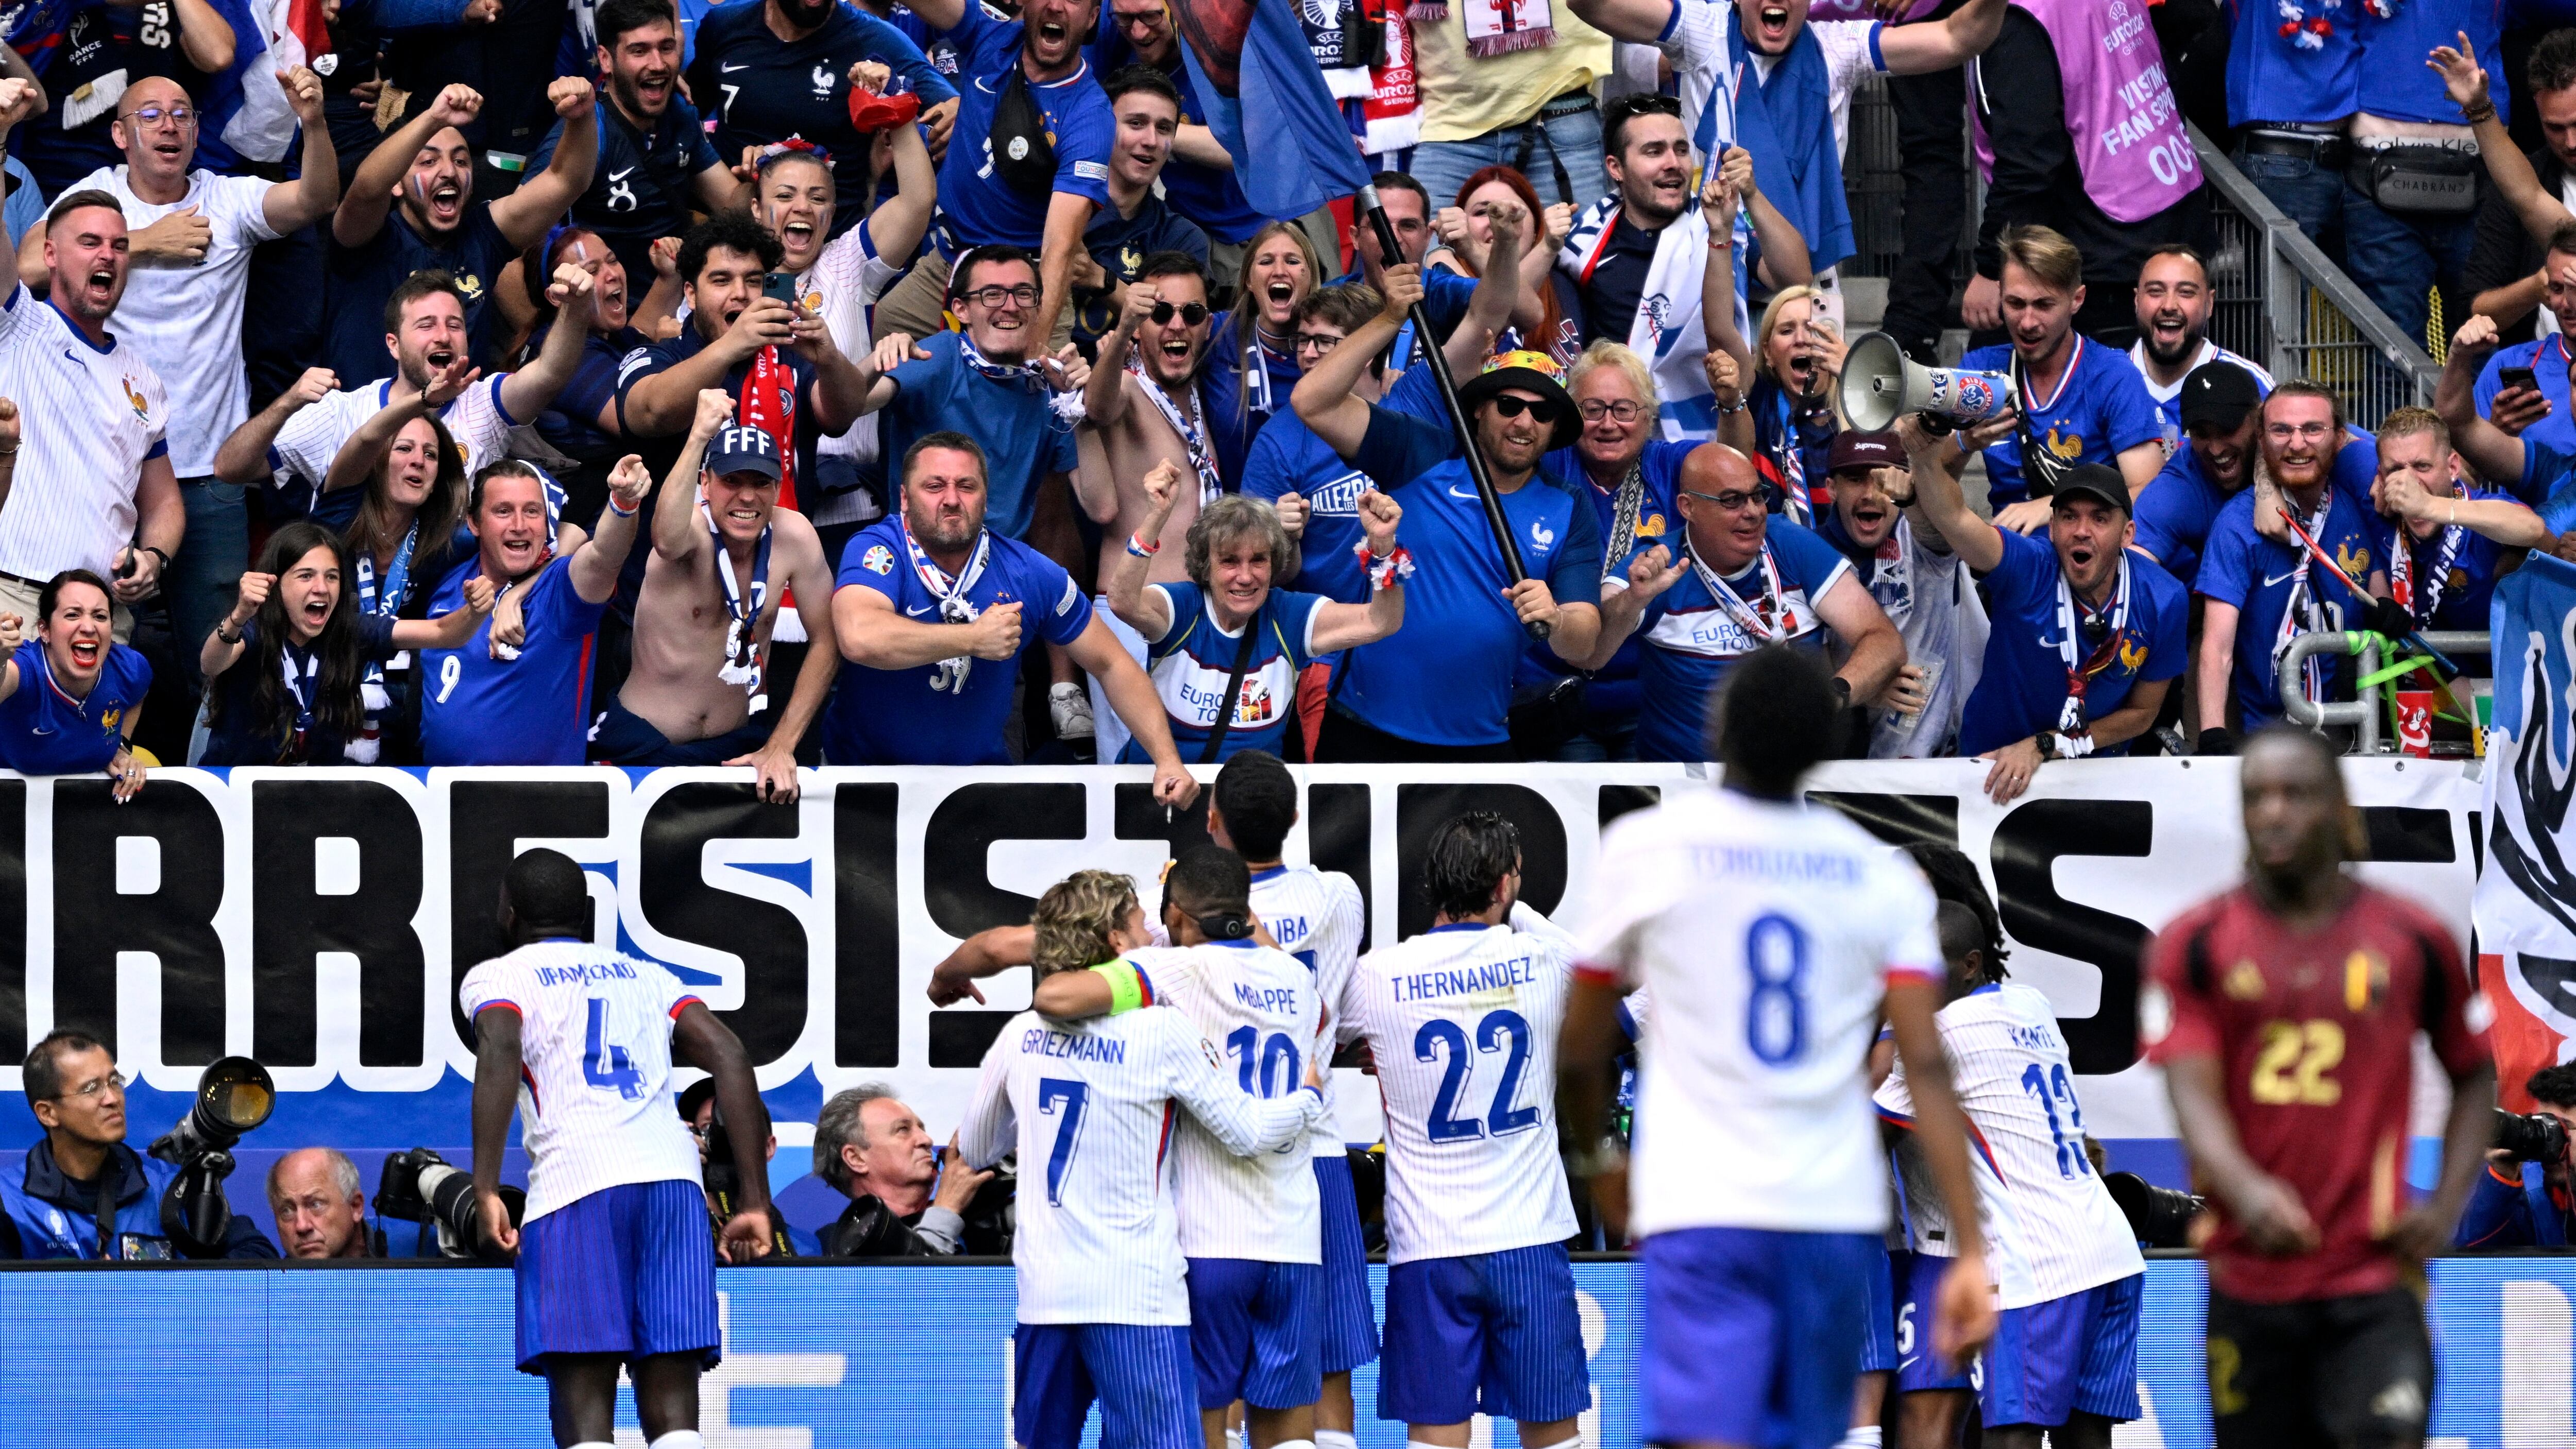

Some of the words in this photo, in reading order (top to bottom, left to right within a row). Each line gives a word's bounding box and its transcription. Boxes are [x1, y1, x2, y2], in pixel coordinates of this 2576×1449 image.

[1386, 72, 1412, 82] UEFA
[721, 83, 740, 124] 7
[2102, 109, 2155, 156] FAN
[724, 427, 770, 454] FFF
[1854, 442, 1887, 452] Supreme
[1312, 481, 1353, 513] ALLEZ
[1344, 501, 1355, 512] LES
[1692, 623, 1749, 644] EURO
[436, 655, 461, 704] 9
[1180, 683, 1240, 708] EURO
[1197, 706, 1241, 723] TOR
[1264, 916, 1309, 945] IBA
[1391, 956, 1535, 1003] T.HERNANDEZ
[1745, 912, 1807, 1068] 8
[1234, 982, 1297, 1015] MBAPPE
[583, 997, 647, 1102] 4
[1021, 1029, 1125, 1065] GRIEZMANN
[2249, 1018, 2346, 1107] 22
[1226, 1025, 1303, 1115] 10
[1414, 1010, 1541, 1144] 22
[1039, 1078, 1090, 1208] 7
[719, 1190, 730, 1214] Nikon
[775, 1232, 787, 1253] Nikon
[1897, 1301, 1916, 1355] 5
